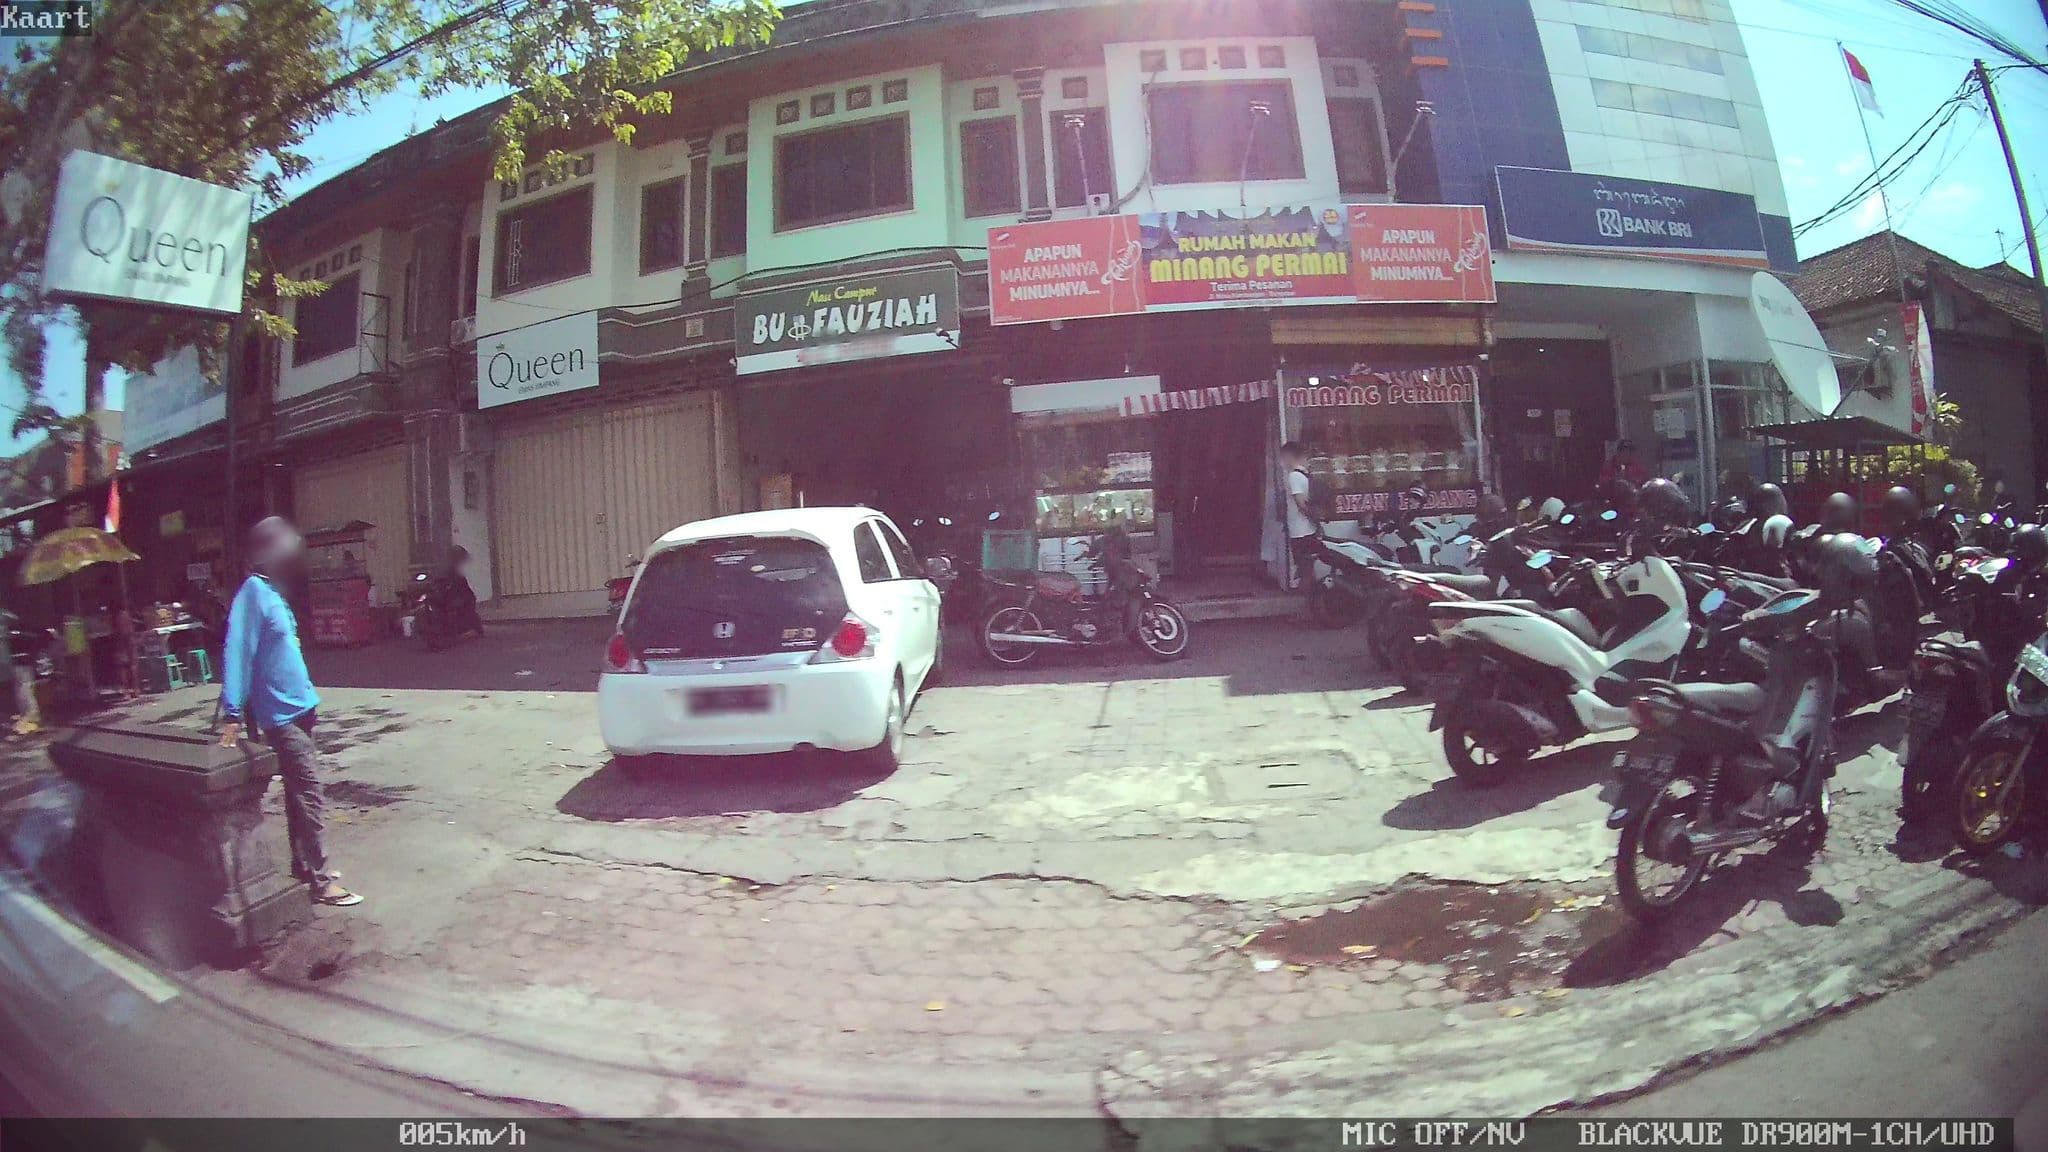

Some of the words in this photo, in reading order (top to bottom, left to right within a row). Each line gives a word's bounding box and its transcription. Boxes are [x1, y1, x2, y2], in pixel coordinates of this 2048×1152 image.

[80, 196, 226, 277] Queen
[1382, 229, 1436, 244] APAPUN
[1623, 216, 1667, 236] BANK
[1668, 221, 1693, 238] BRI
[1023, 243, 1082, 263] APAPUN
[1178, 234, 1246, 252] RUMAH
[1249, 232, 1318, 249] MAKAN
[1359, 247, 1453, 263] MAKANANNYA
[1000, 260, 1099, 284] MAKANANNYA
[1150, 254, 1249, 283] MINANG
[1255, 252, 1348, 277] PERMAI
[1209, 281, 1247, 292] Terima
[1249, 280, 1293, 291] Pesanan
[753, 312, 786, 345] BU
[811, 293, 937, 338] FAUZIAH
[488, 348, 584, 390] Queen
[1287, 385, 1382, 408] MINANG
[1387, 383, 1474, 405] PERMAI
